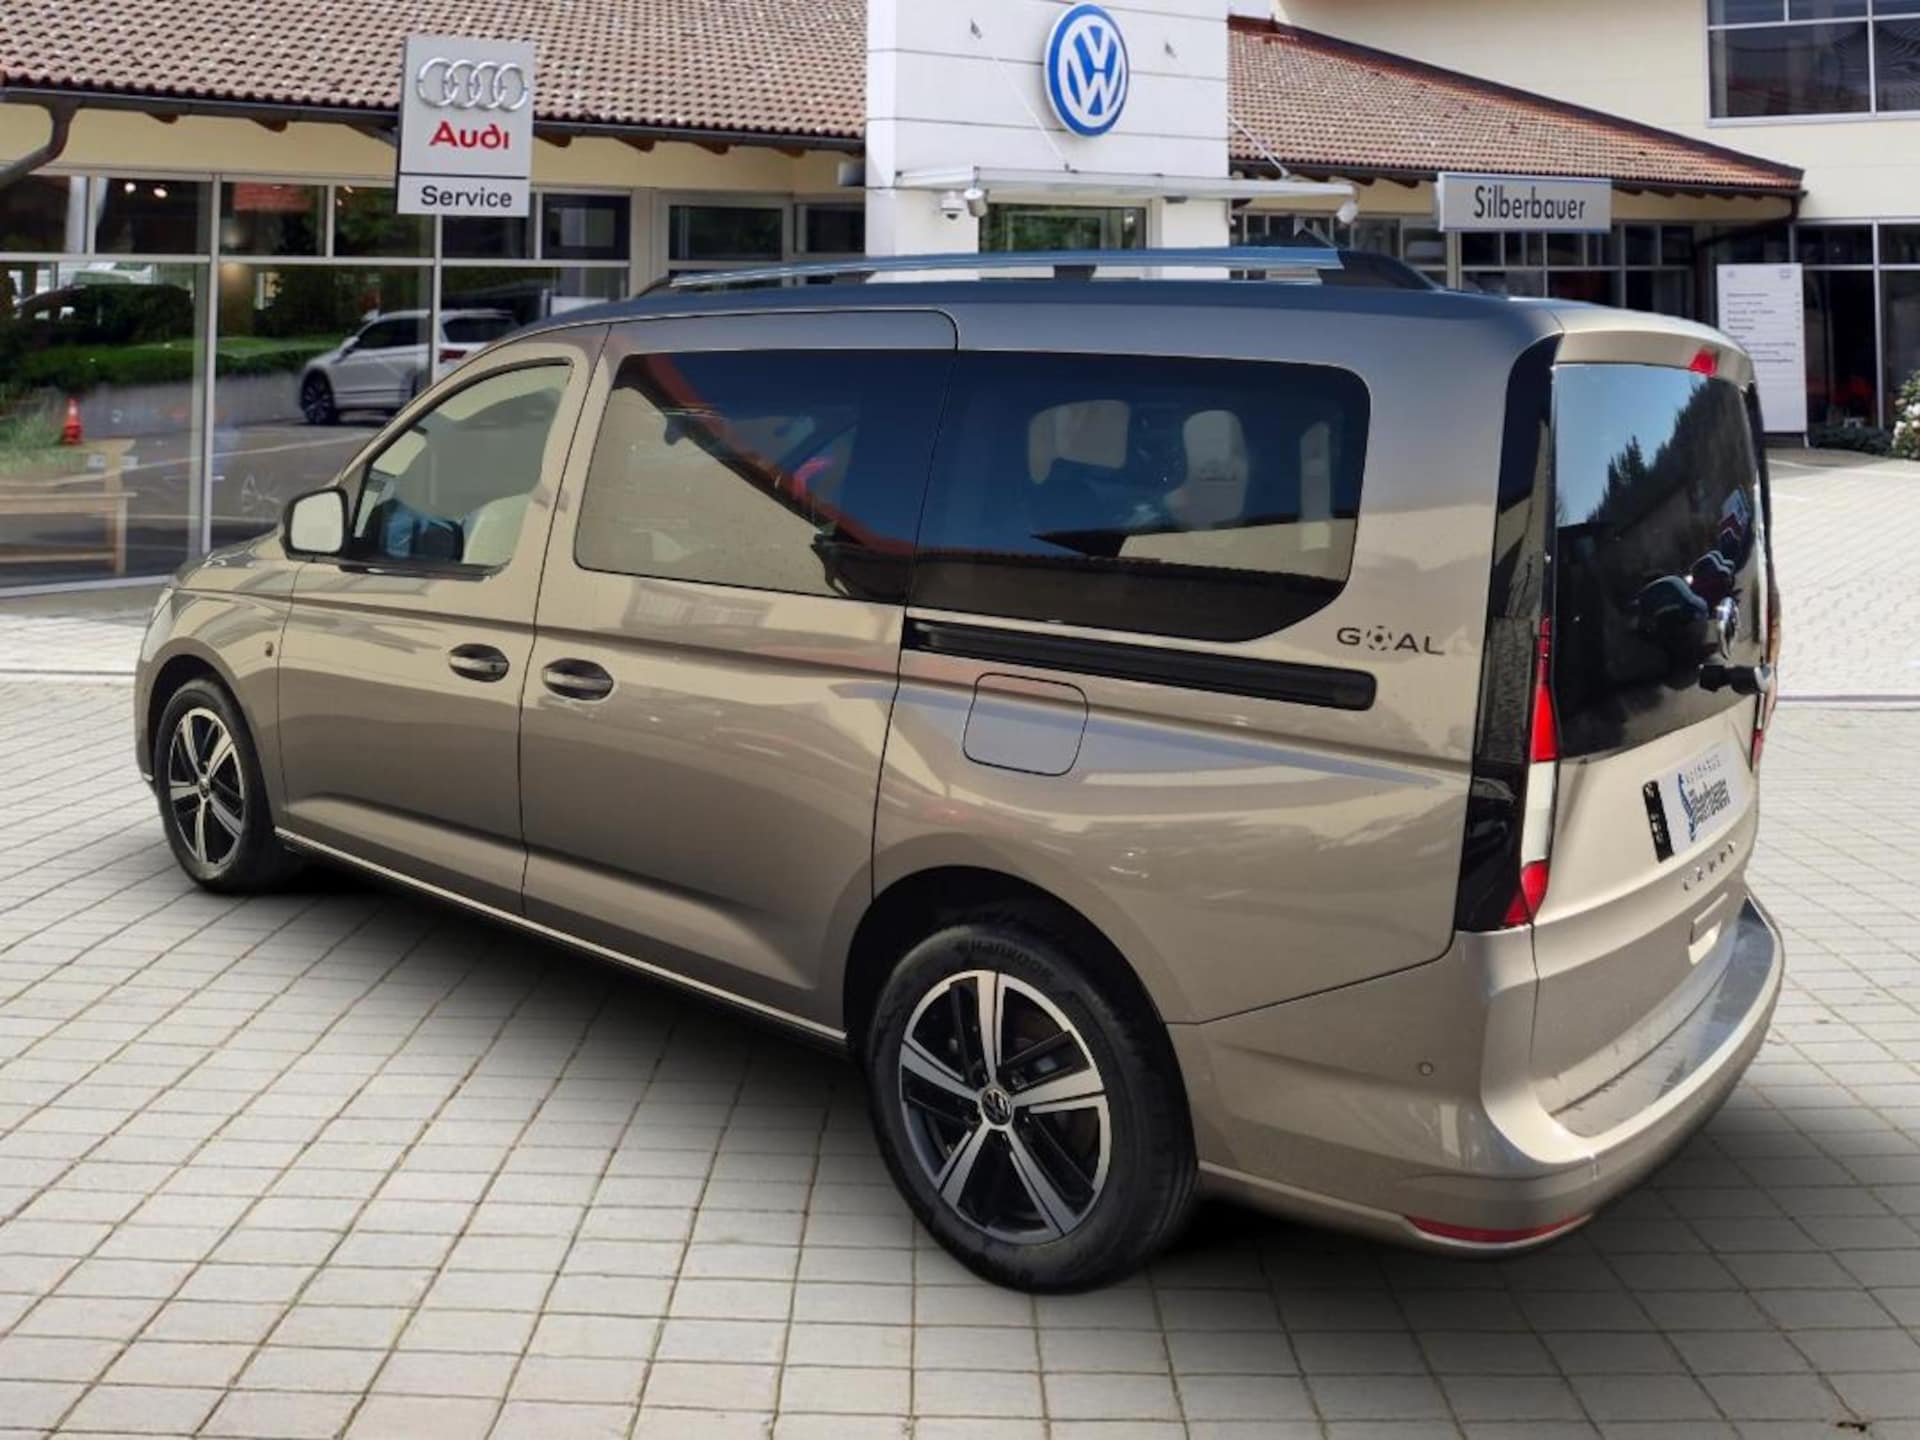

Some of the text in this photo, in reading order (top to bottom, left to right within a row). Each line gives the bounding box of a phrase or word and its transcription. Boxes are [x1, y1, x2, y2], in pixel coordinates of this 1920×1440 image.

[429, 121, 509, 149] Audi
[420, 185, 513, 208] Service
[1473, 185, 1586, 219] Silberbauer
